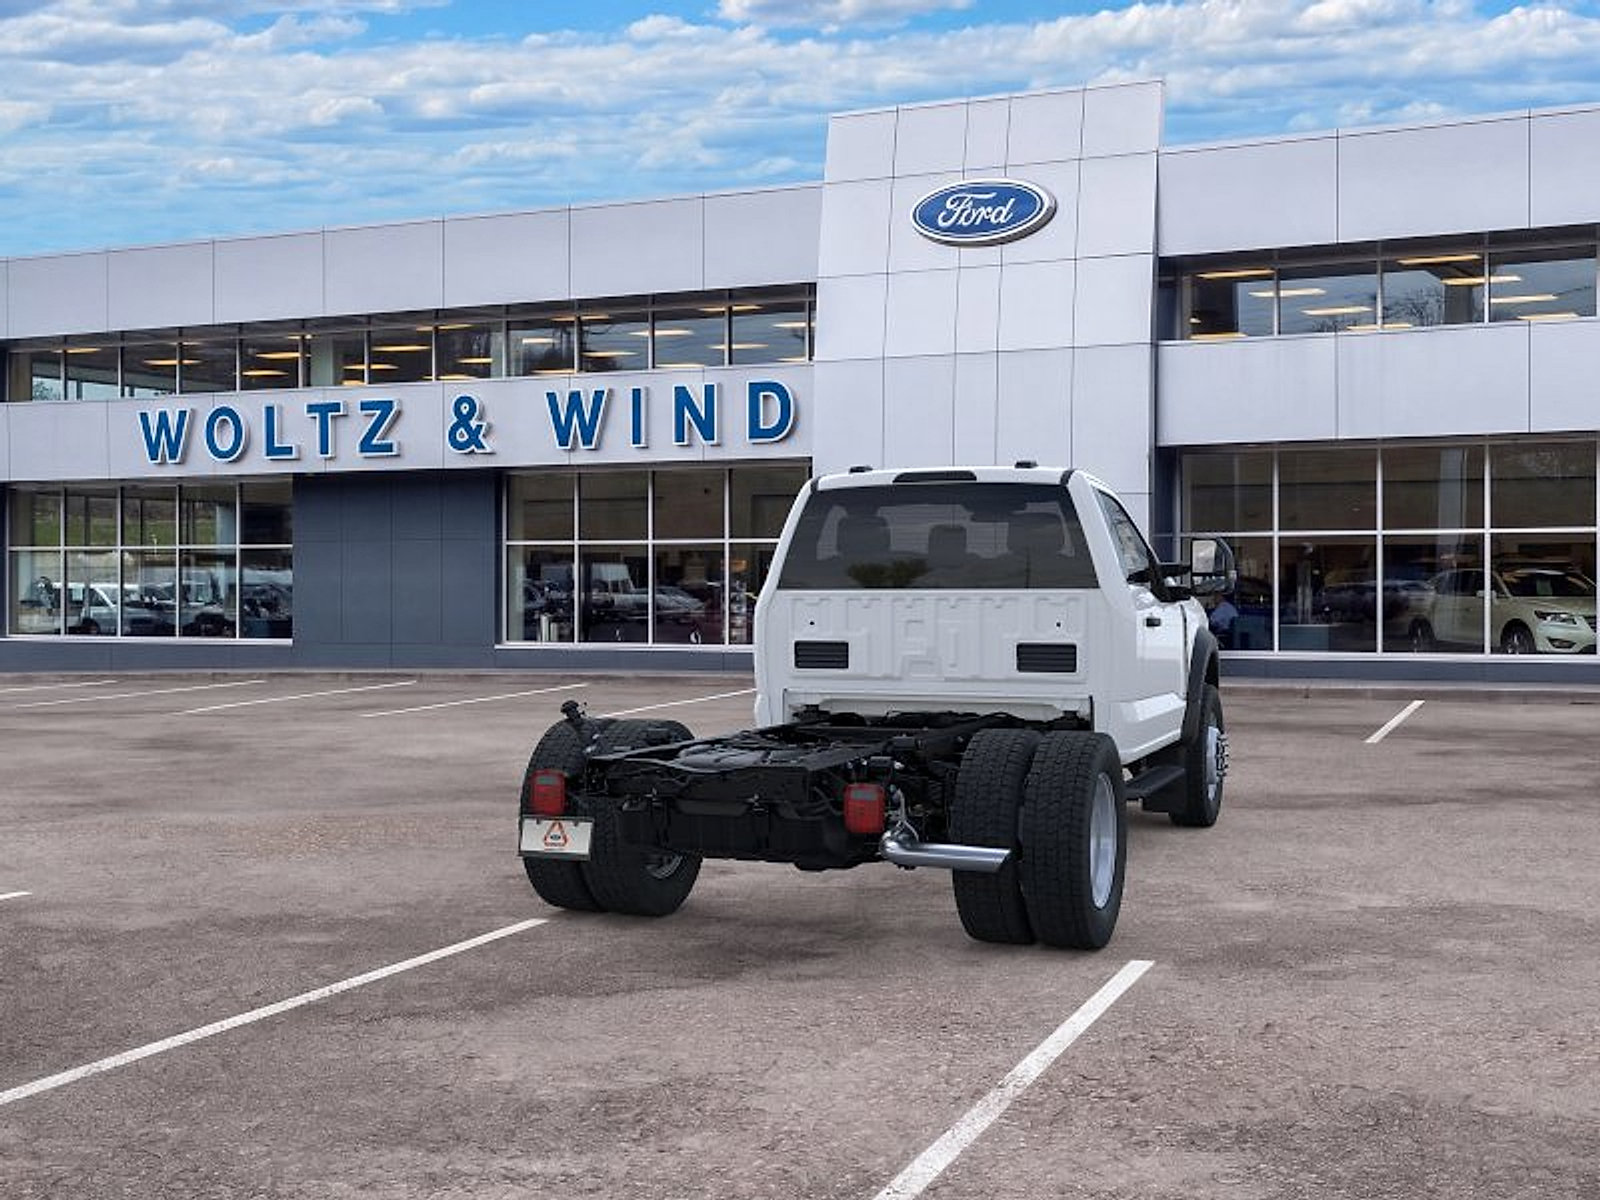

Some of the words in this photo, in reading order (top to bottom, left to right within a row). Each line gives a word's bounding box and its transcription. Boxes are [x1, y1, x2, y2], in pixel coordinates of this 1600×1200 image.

[937, 191, 1016, 228] Ford
[138, 398, 402, 464] WOLTZ
[448, 394, 492, 454] &
[546, 380, 797, 450] WIND
